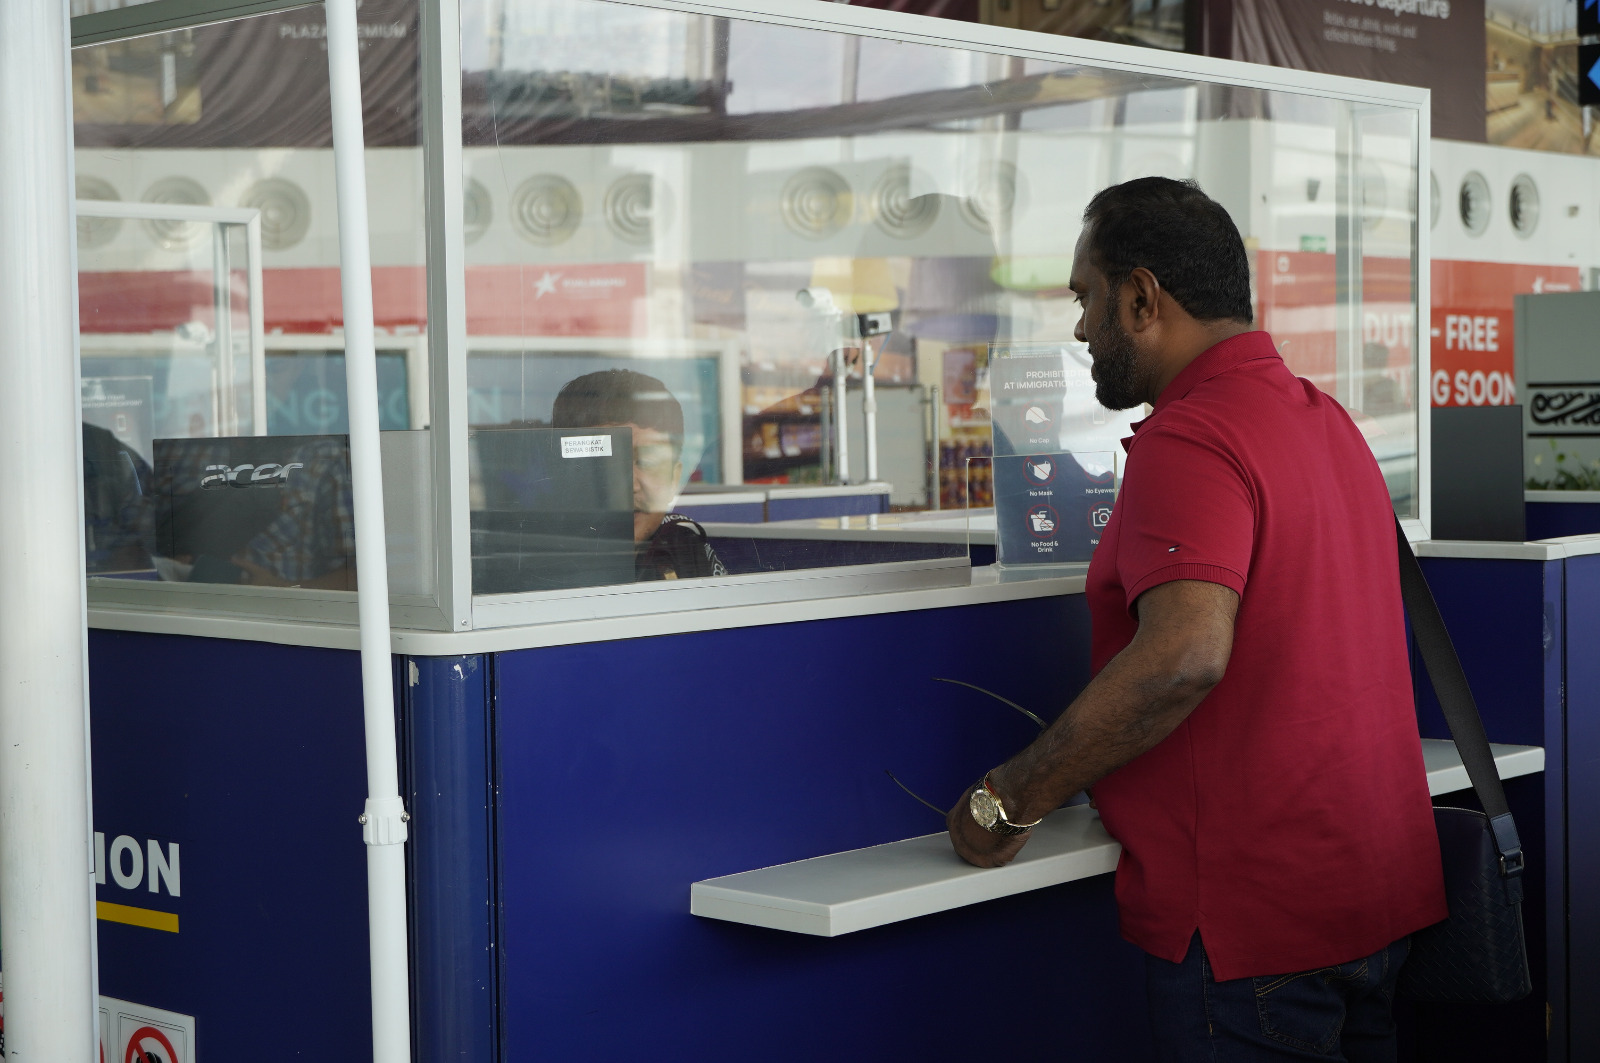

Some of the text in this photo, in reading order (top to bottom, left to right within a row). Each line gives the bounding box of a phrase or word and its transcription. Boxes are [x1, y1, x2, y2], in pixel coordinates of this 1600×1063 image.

[1363, 311, 1414, 348] DUT
[1446, 314, 1499, 352] FREE
[1004, 382, 1015, 390] AT
[1016, 379, 1074, 389] IMMIGRATION
[200, 463, 304, 490] acer
[94, 831, 181, 897] ION
